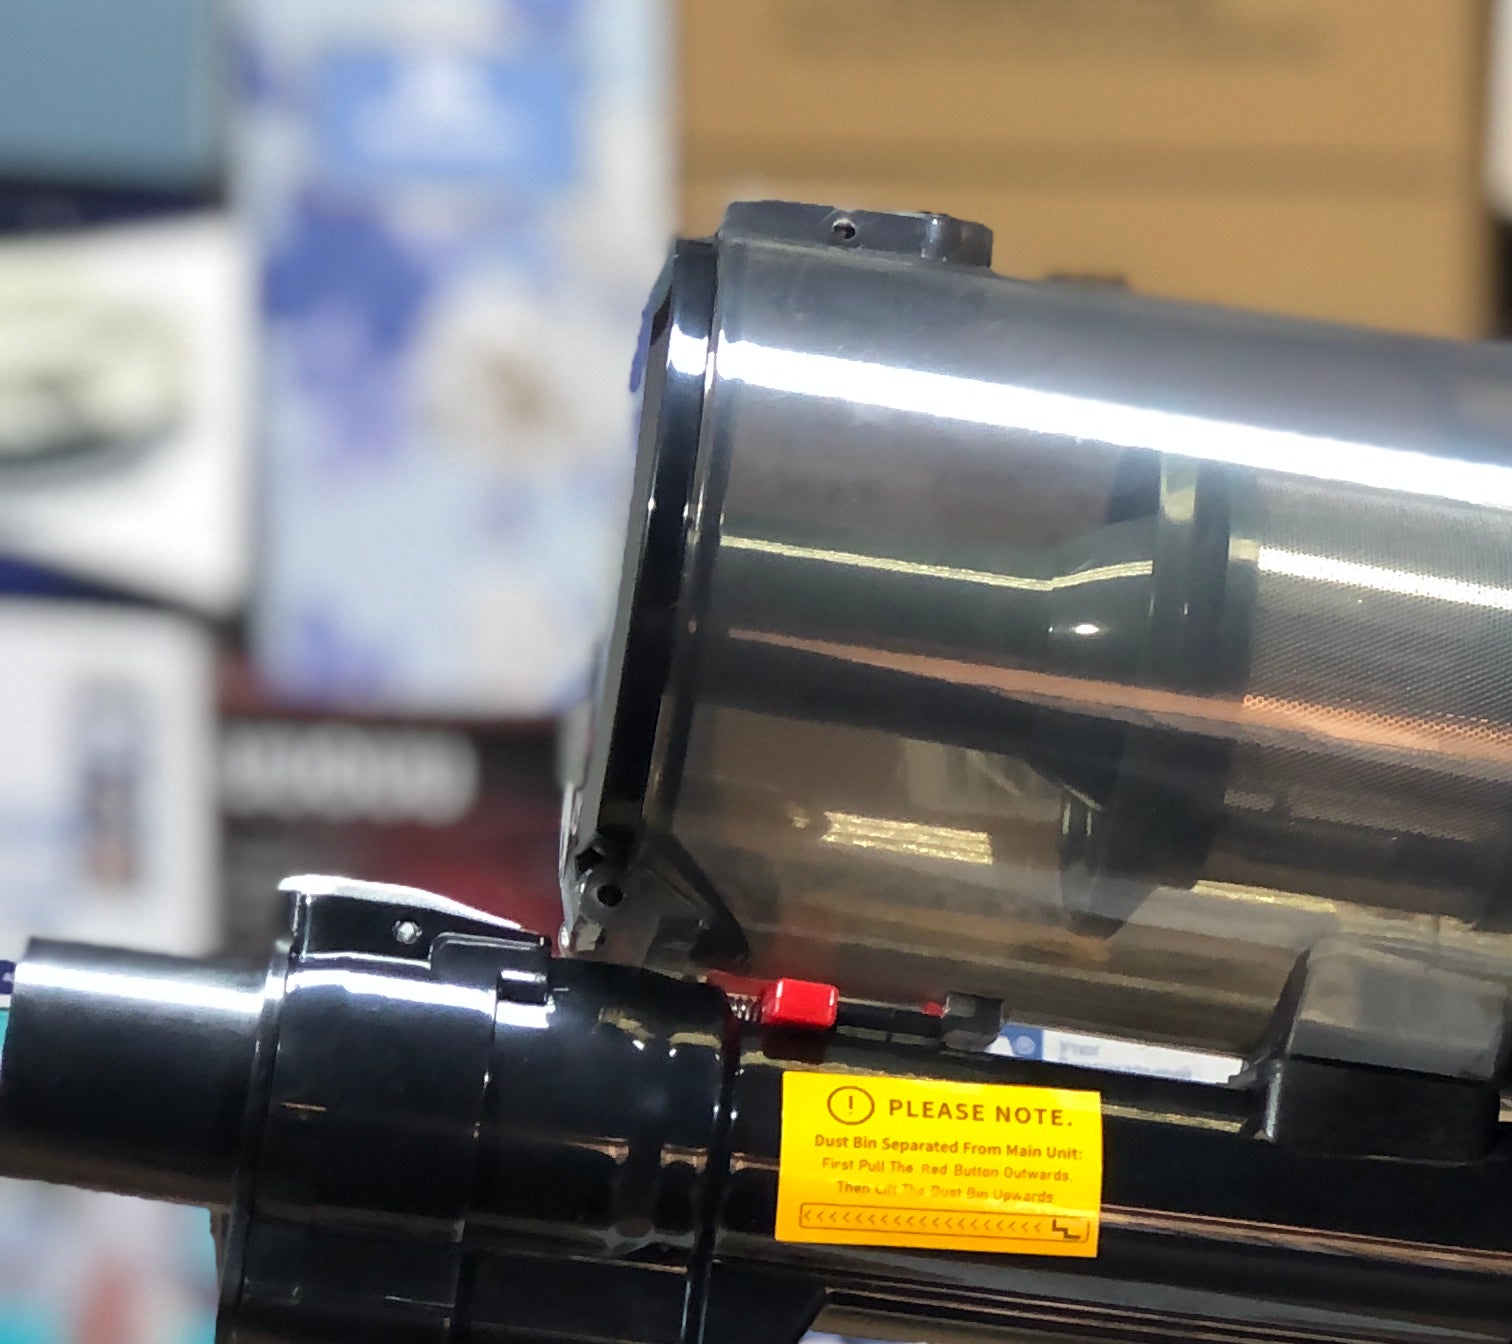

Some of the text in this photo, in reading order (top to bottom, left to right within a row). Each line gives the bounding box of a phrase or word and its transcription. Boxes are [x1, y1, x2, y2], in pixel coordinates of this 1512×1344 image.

[889, 1099, 1073, 1127] PLEASE NOTE.
[815, 1134, 1083, 1160] Dust Bin Separated From Main Unit:
[822, 1157, 854, 1171] First
[859, 1159, 885, 1172] Pull
[890, 1161, 914, 1174] The
[921, 1163, 948, 1176] Red
[954, 1164, 999, 1178] Button
[837, 1180, 870, 1194] Then
[930, 1185, 961, 1198] Dust
[966, 1186, 988, 1200] Bin
[993, 1188, 1054, 1204] Upwards
